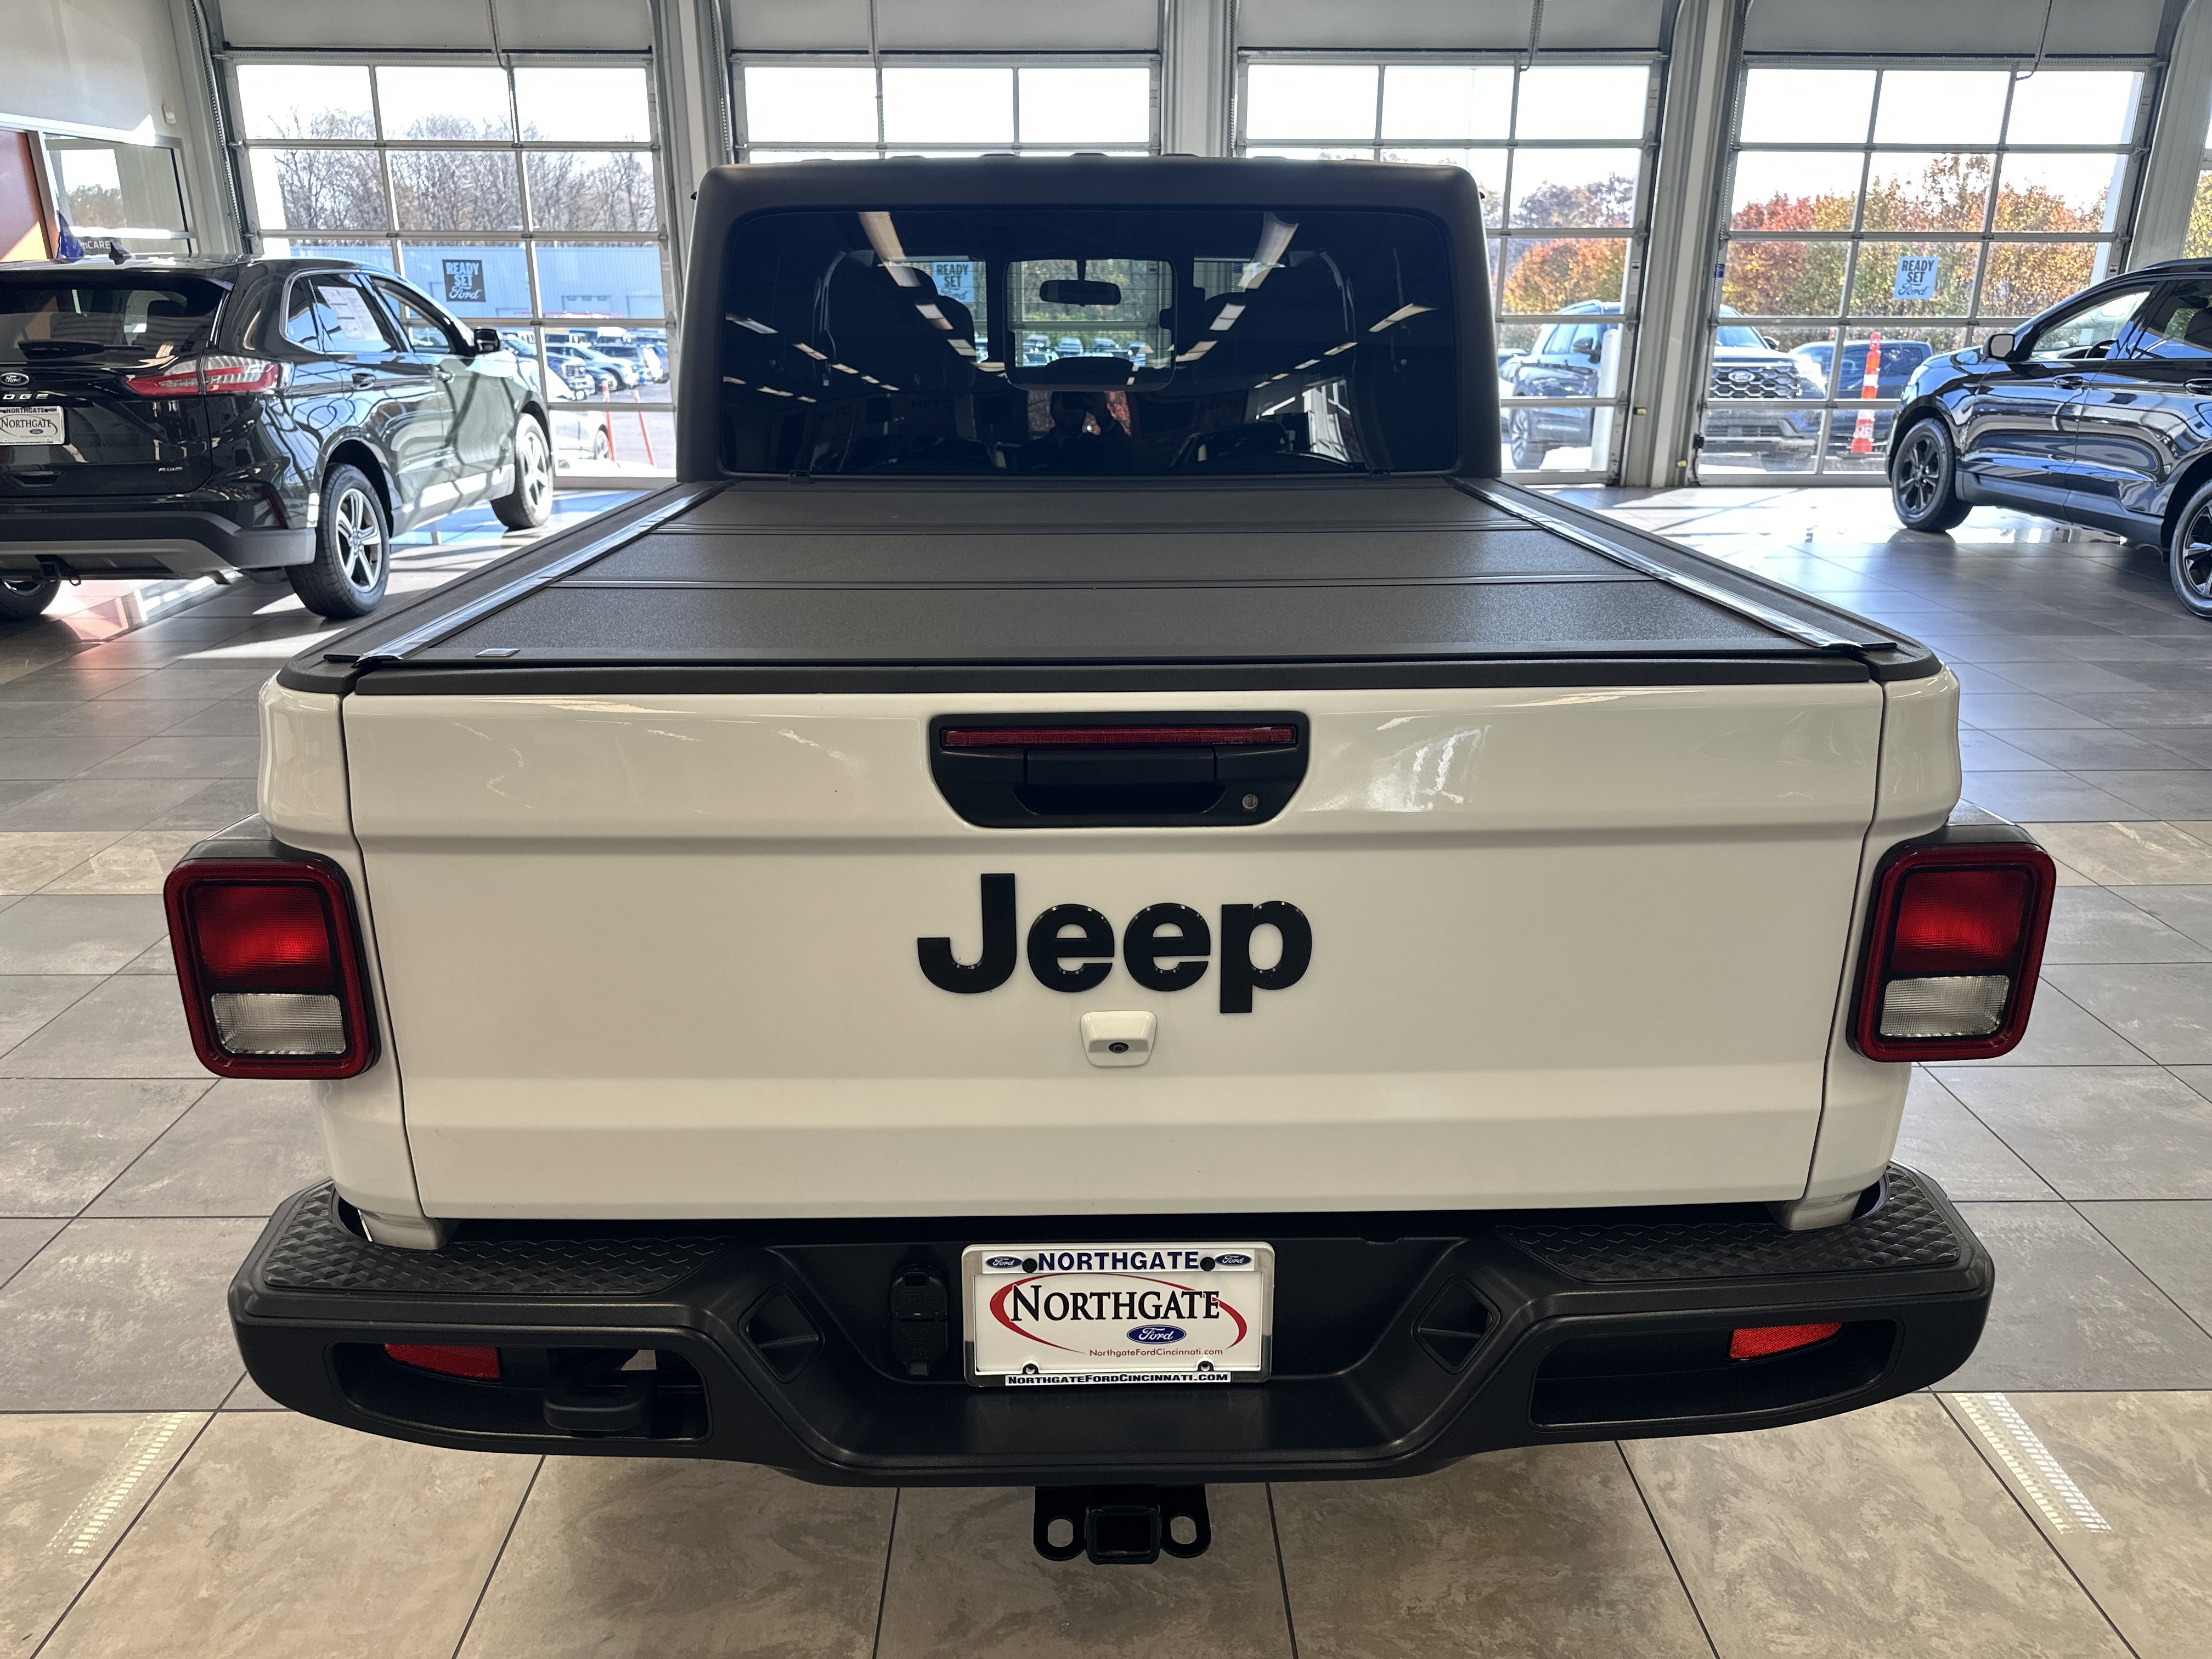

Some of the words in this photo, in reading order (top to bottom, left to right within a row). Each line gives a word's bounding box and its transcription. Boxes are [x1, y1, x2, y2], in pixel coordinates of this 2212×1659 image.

[445, 262, 479, 275] READY
[936, 264, 968, 275] READY
[1901, 260, 1934, 271] READY
[454, 274, 472, 285] SET
[944, 275, 961, 287] SET
[1906, 272, 1925, 283] SET
[449, 286, 482, 299] Ford
[1898, 283, 1931, 295] Ford
[4, 375, 22, 383] Ford
[1, 417, 51, 428] NORTHGATE
[917, 873, 1312, 1013] Jeep
[992, 1257, 1015, 1266] Ford
[1039, 1251, 1199, 1271] NORTHGATE
[1222, 1255, 1244, 1264] Ford
[1011, 1284, 1220, 1322] NORTHGATE
[1138, 1327, 1175, 1340] Ford
[1090, 1348, 1223, 1358] NorthgateFordCincinnati.com
[1008, 1373, 1228, 1384] NORTHGATEFORDCINCINNATI.COM
